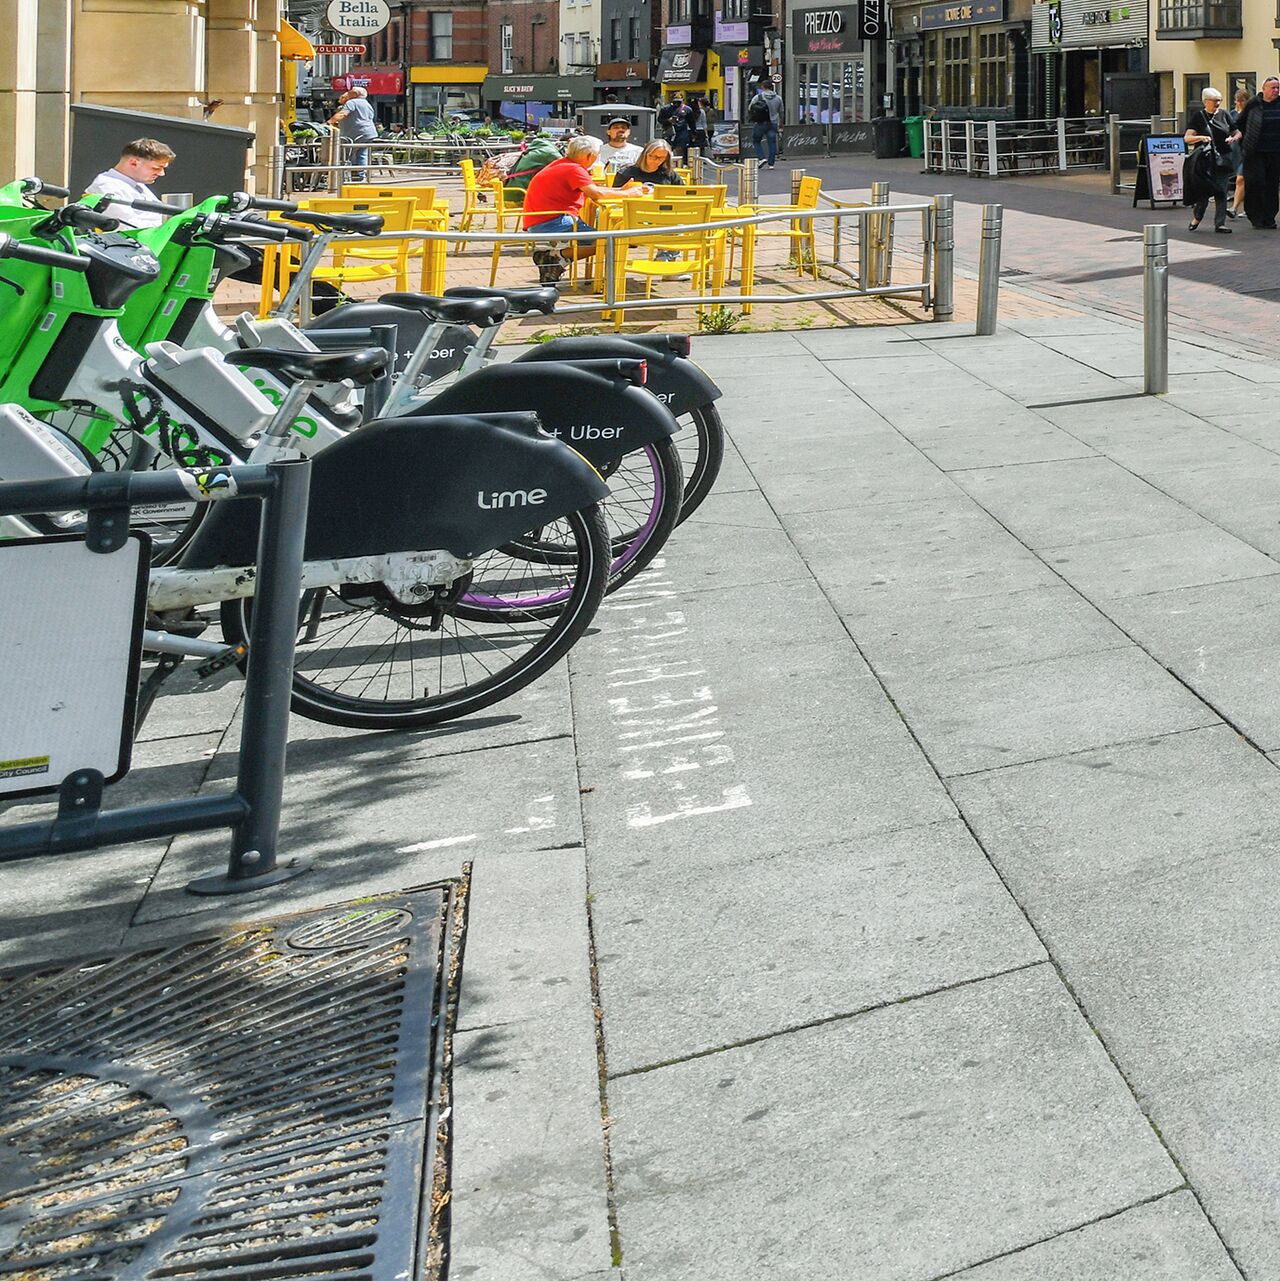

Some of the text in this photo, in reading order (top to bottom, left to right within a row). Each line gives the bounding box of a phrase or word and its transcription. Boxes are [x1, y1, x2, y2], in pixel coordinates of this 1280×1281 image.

[339, 1, 379, 13] Bella
[339, 15, 380, 27] Italia
[805, 11, 841, 34] PREZZO
[571, 425, 625, 441] Uber
[477, 487, 549, 510] Lime
